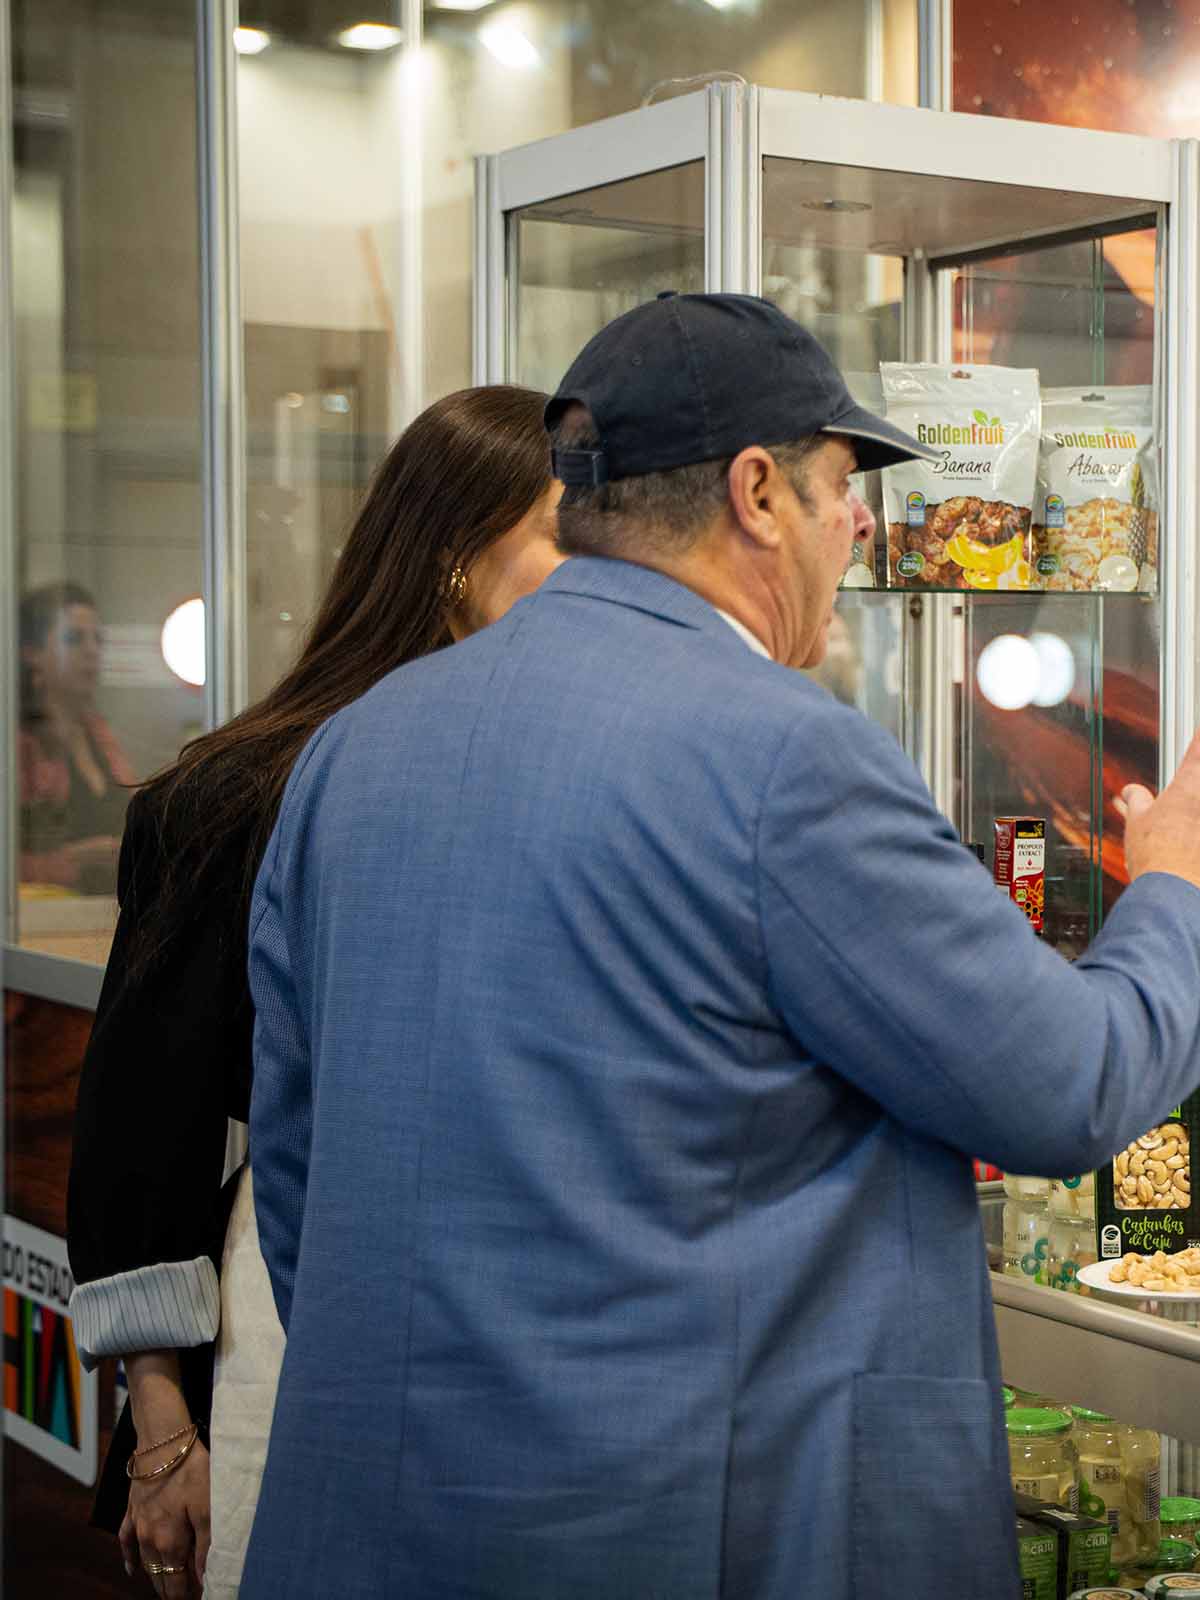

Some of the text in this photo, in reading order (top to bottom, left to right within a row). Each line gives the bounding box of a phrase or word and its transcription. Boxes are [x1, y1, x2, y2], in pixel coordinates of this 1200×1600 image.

[917, 423, 1004, 445] GoldenFruit
[932, 450, 992, 474] Banana
[1121, 1214, 1185, 1235] Castanhas
[1128, 1234, 1172, 1252] de Caju
[27, 1250, 76, 1308] ESTAD
